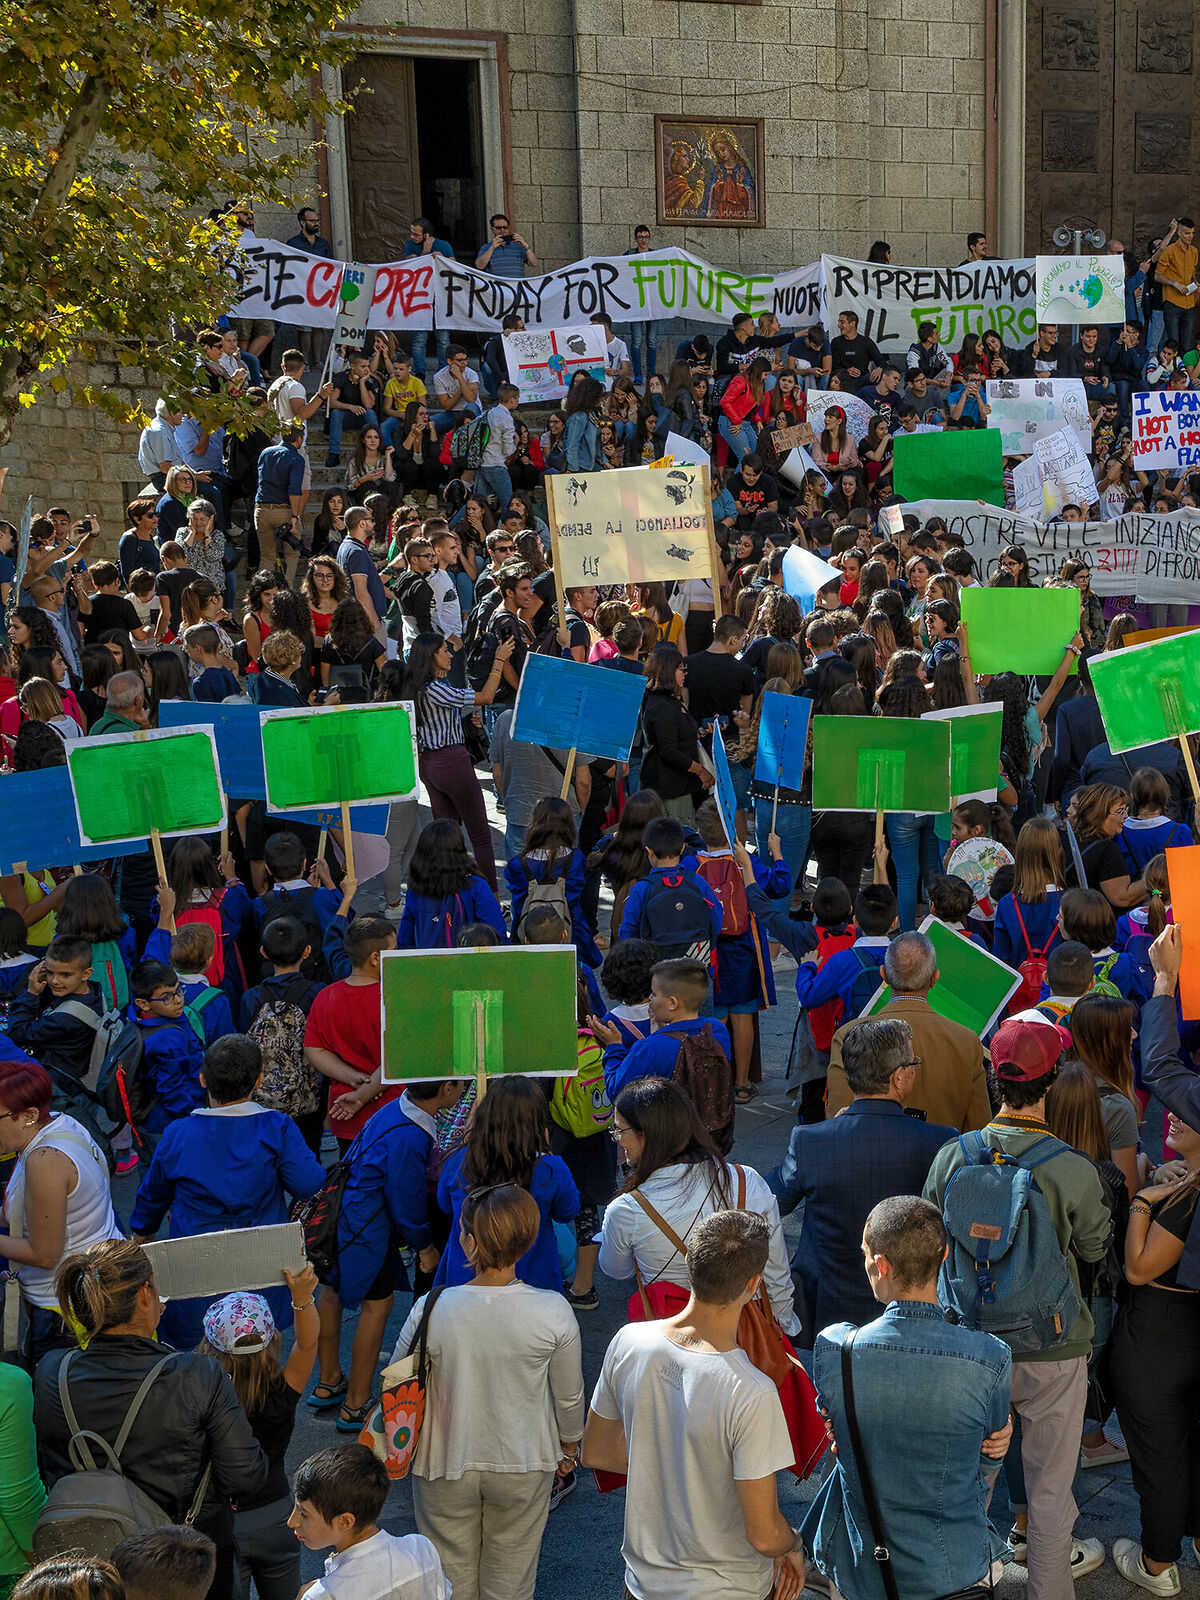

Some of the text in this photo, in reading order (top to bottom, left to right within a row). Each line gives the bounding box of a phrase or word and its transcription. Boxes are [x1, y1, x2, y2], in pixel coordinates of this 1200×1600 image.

[439, 269, 553, 324] FRIDAY
[557, 262, 631, 320] FOR
[628, 258, 775, 319] FUTURE
[864, 303, 1037, 347] IL FUTURO
[1134, 393, 1151, 416] I
[1138, 415, 1172, 437] HOT
[1133, 437, 1163, 456] NOT
[1164, 435, 1177, 450] A
[1033, 521, 1102, 550] VITE
[1096, 548, 1139, 574] ZITTI
